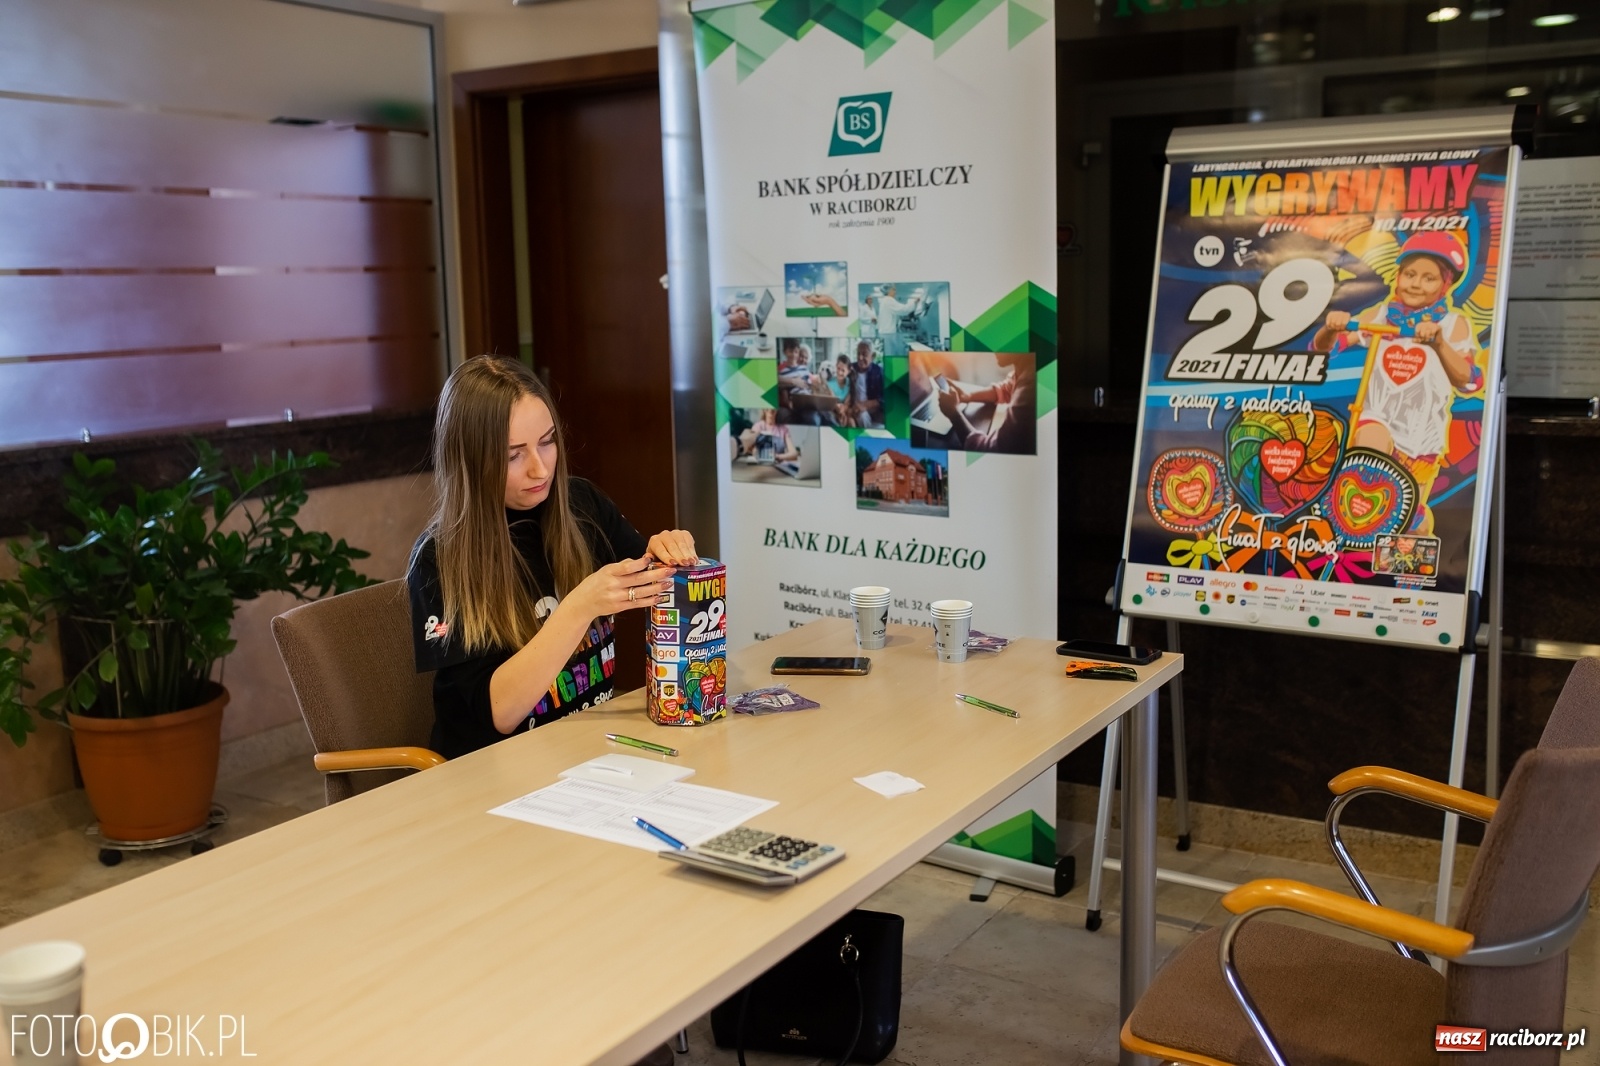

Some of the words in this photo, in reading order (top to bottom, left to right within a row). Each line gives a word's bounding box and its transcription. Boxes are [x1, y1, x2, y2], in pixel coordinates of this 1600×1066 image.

[849, 113, 871, 130] BS
[1365, 152, 1438, 164] DIAGNOSTYKA
[758, 177, 812, 198] BANK
[816, 164, 974, 195] SPÓŁDZIELCZY
[1190, 164, 1478, 217] WYGRYWAMY
[810, 202, 824, 216] W
[827, 196, 917, 215] RACIBORZU
[1376, 216, 1469, 232] 10.01.2021
[1199, 245, 1220, 256] tvn
[1168, 258, 1335, 379] 29
[1176, 359, 1221, 373] 2021
[1224, 354, 1326, 382] FINAŁ
[763, 528, 820, 552] BANK
[825, 534, 868, 557] DLA
[874, 538, 986, 571] KAŻDEGO
[1179, 576, 1202, 585] PLAY
[1210, 578, 1236, 589] allegro
[779, 582, 819, 597] Racibórz,
[894, 599, 908, 609] tel.
[912, 600, 923, 611] 32
[784, 601, 824, 616] Racibórz,
[838, 609, 853, 619] Ban
[686, 599, 724, 643] 29
[664, 687, 675, 697] ups
